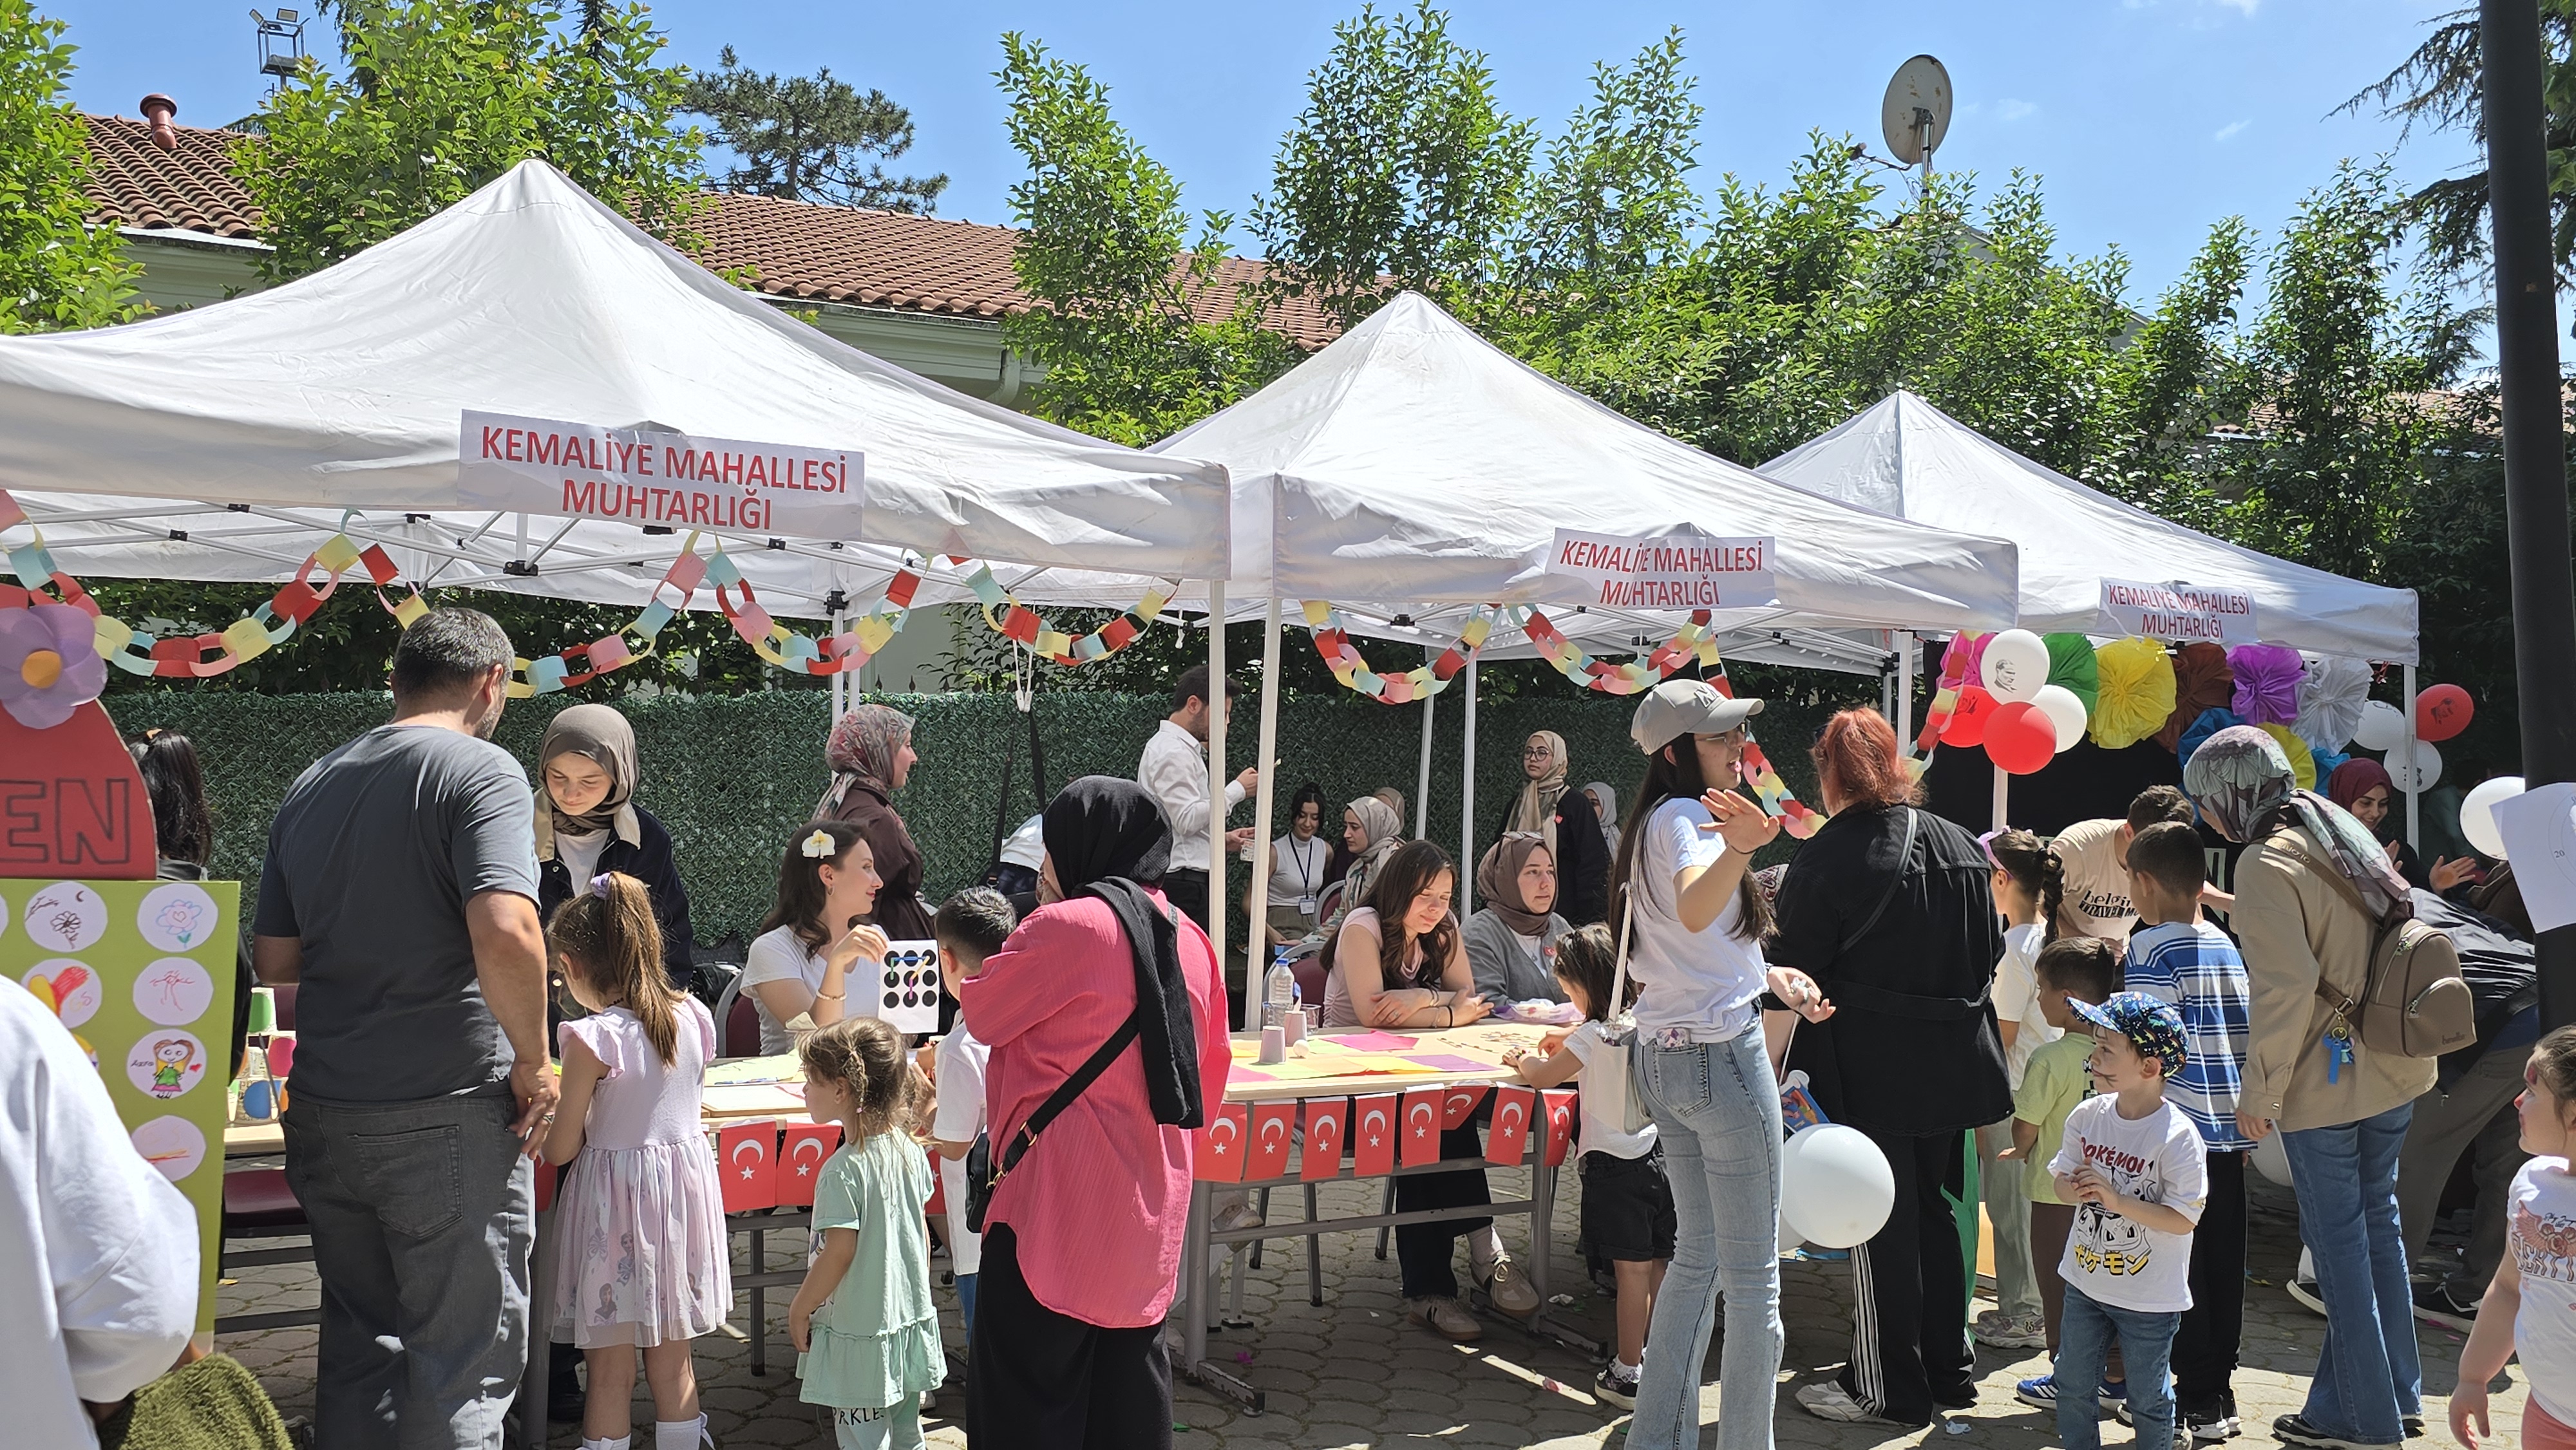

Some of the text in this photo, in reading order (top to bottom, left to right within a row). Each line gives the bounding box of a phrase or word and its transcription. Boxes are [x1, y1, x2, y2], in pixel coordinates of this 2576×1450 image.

[482, 426, 846, 493] KEMALİYE MAHALLESİ
[562, 480, 770, 530] MUHTARLIĞI
[1654, 541, 1763, 572] MAHALLESİ
[1600, 574, 1721, 606] MUHTARLIĞI
[2108, 585, 2250, 616] KEMALİYE MAHALLESİ
[2141, 614, 2224, 639] MUHTARLIĞI
[2553, 849, 2565, 858] 20
